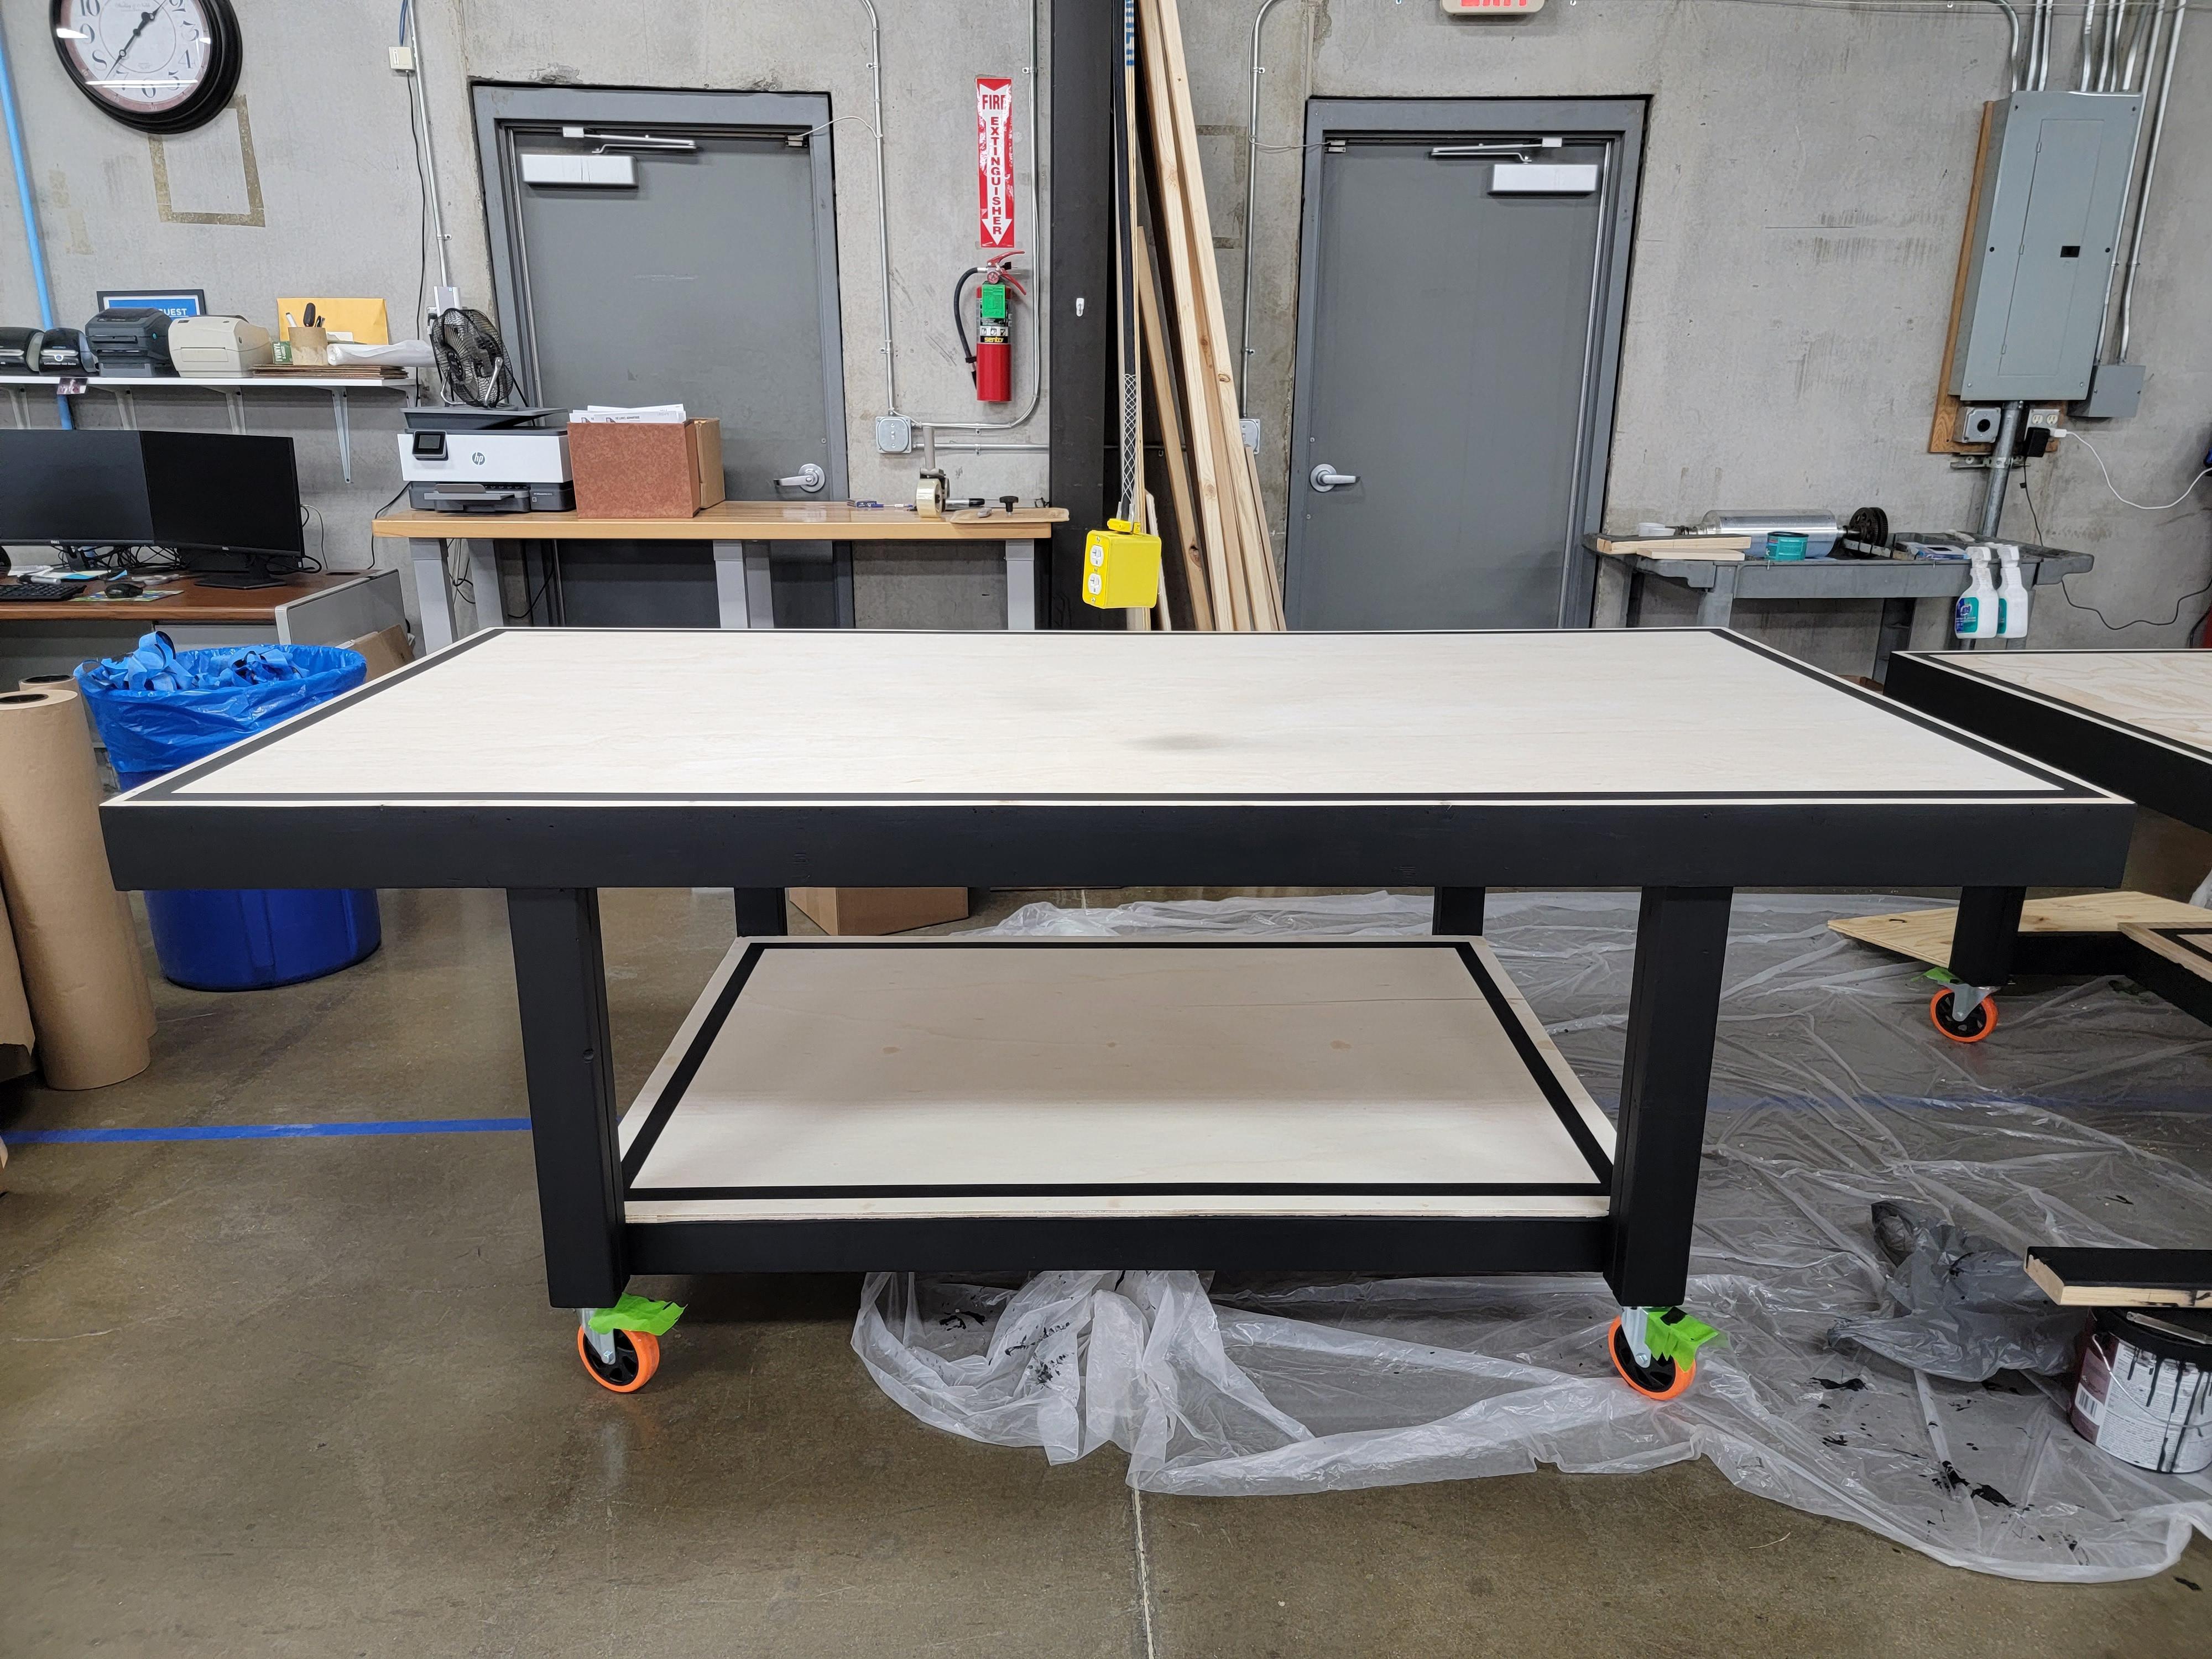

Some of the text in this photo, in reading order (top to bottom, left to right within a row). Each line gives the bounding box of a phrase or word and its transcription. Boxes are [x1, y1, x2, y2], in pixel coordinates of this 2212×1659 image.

[80, 23, 95, 44] 9
[179, 20, 200, 41] 3
[92, 50, 107, 71] 8
[178, 49, 196, 69] 4
[116, 70, 129, 90] 7
[141, 78, 156, 98] 6
[168, 70, 180, 91] 5
[990, 116, 1002, 235] EXTINGUISHER
[158, 307, 187, 316] UEST
[273, 342, 282, 359] VINYL
[474, 452, 484, 466] hp
